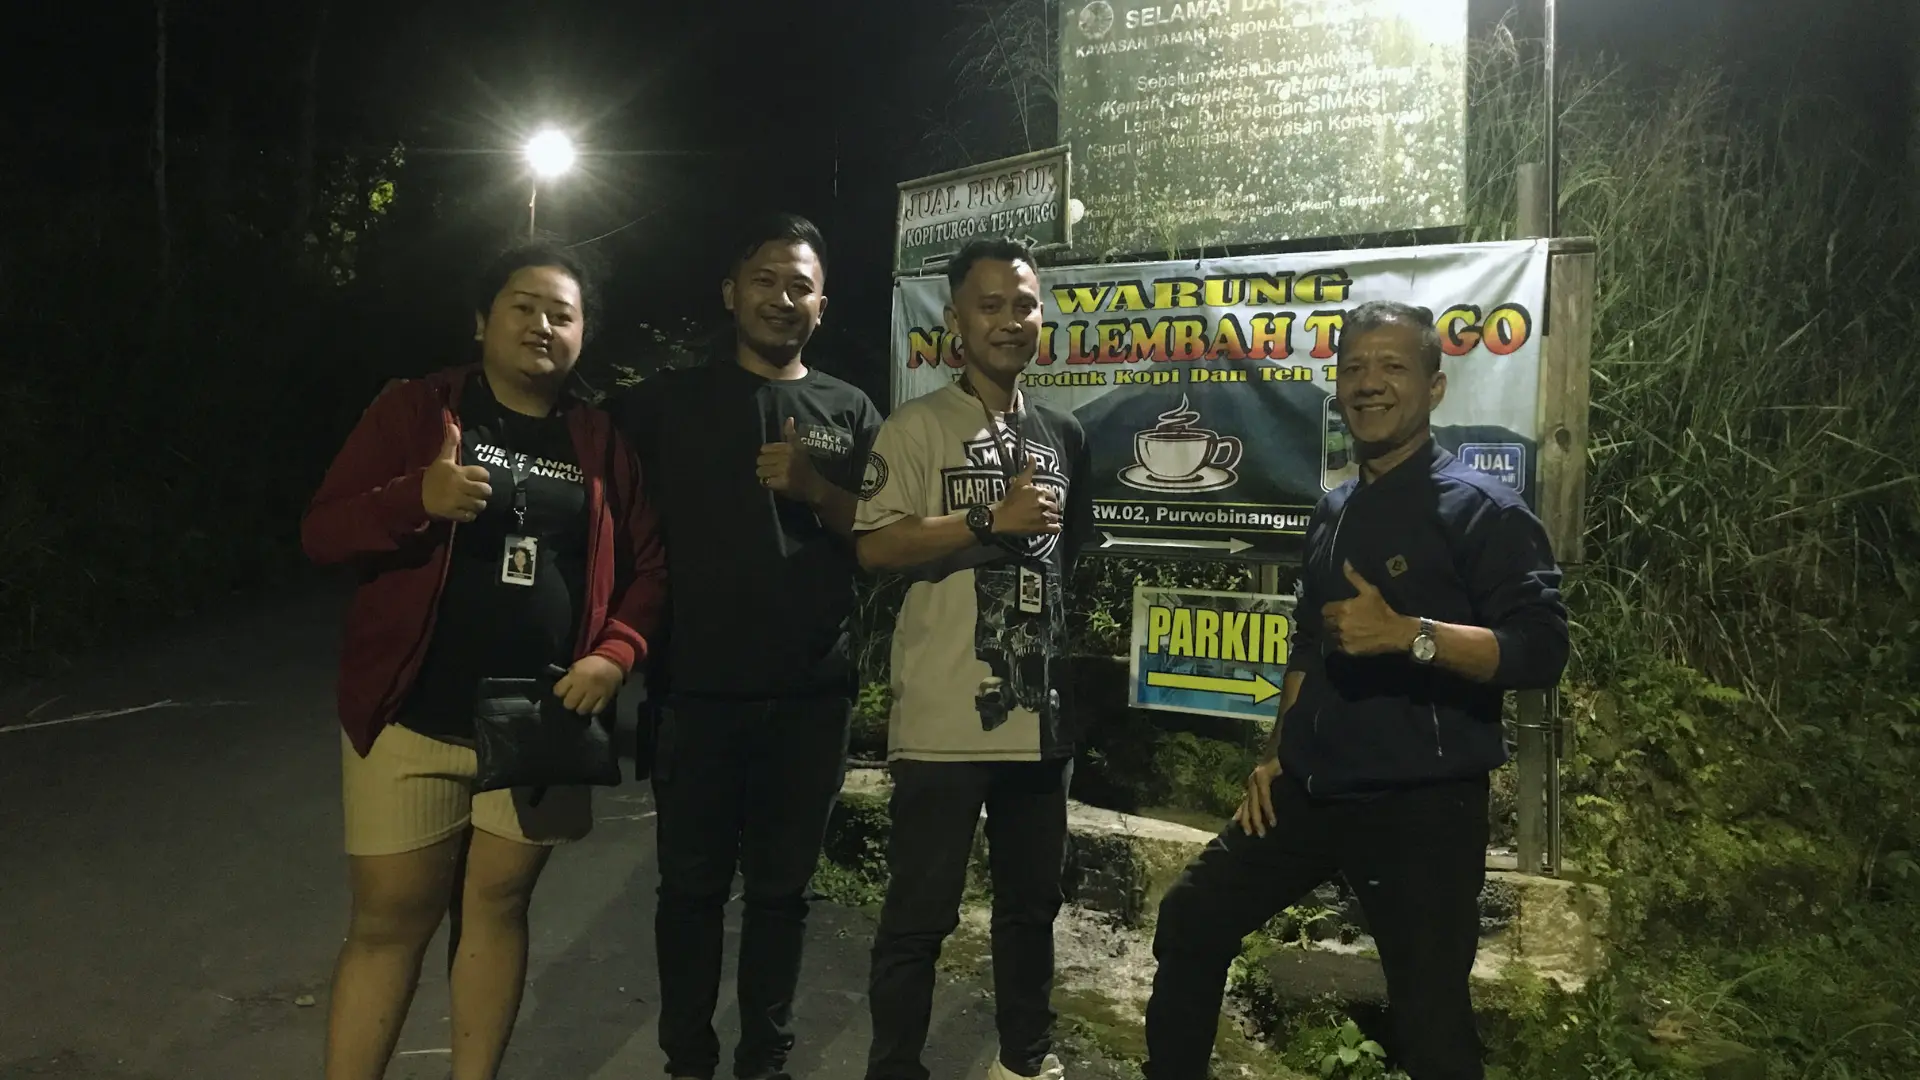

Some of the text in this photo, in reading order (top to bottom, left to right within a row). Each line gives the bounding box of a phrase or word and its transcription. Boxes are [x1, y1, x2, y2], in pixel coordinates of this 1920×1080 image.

[1125, 0, 1231, 29] SELAMAT
[1075, 17, 1290, 58] KAWASAN TAMAN NASIONAL
[1137, 71, 1205, 92] Sebelum
[906, 164, 1059, 221] JUAL PRODUK
[905, 200, 1060, 249] KOPI TURGO & TEH TURGO
[1051, 268, 1353, 315] WARUNG
[906, 302, 1532, 369] NGI LEMBAH TGO
[1113, 368, 1180, 386] Kopi
[1188, 367, 1247, 384] Dan
[1258, 365, 1313, 383] Teh
[800, 437, 848, 455] CURRANT
[809, 430, 842, 445] BLACK
[1468, 453, 1514, 471] JUAL
[1156, 506, 1312, 529] Purwobinangun
[1147, 605, 1290, 665] PARKIR
